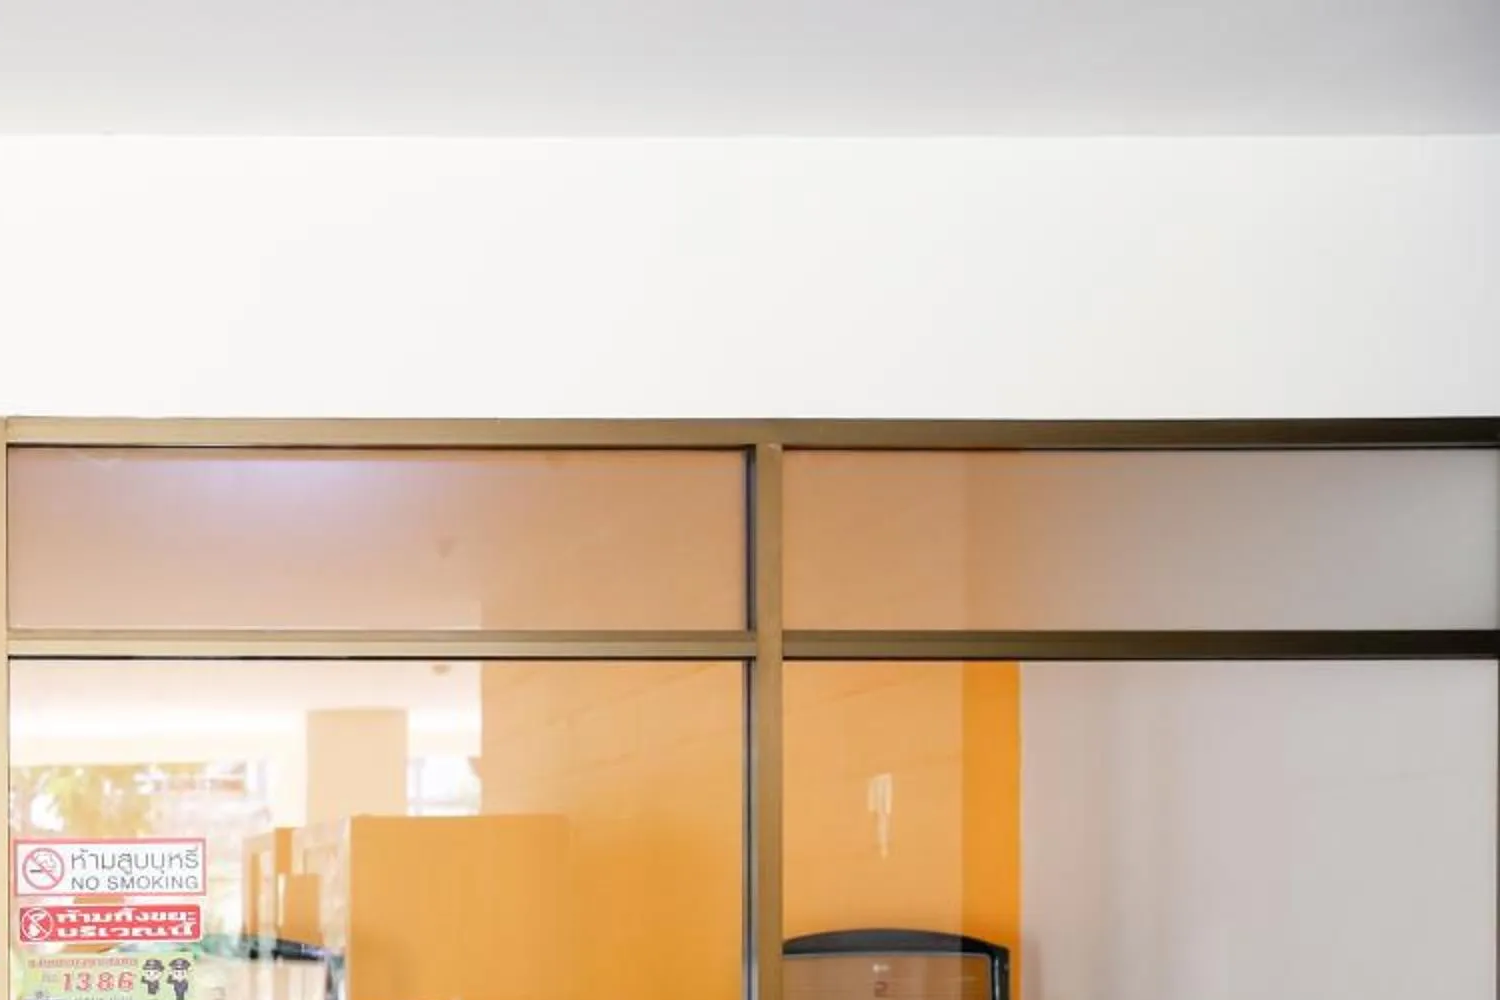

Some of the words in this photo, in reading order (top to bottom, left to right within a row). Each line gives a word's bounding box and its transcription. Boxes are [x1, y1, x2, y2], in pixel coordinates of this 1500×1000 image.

[71, 876, 100, 891] NO
[107, 875, 199, 890] SMOKING
[63, 971, 135, 992] 1386
